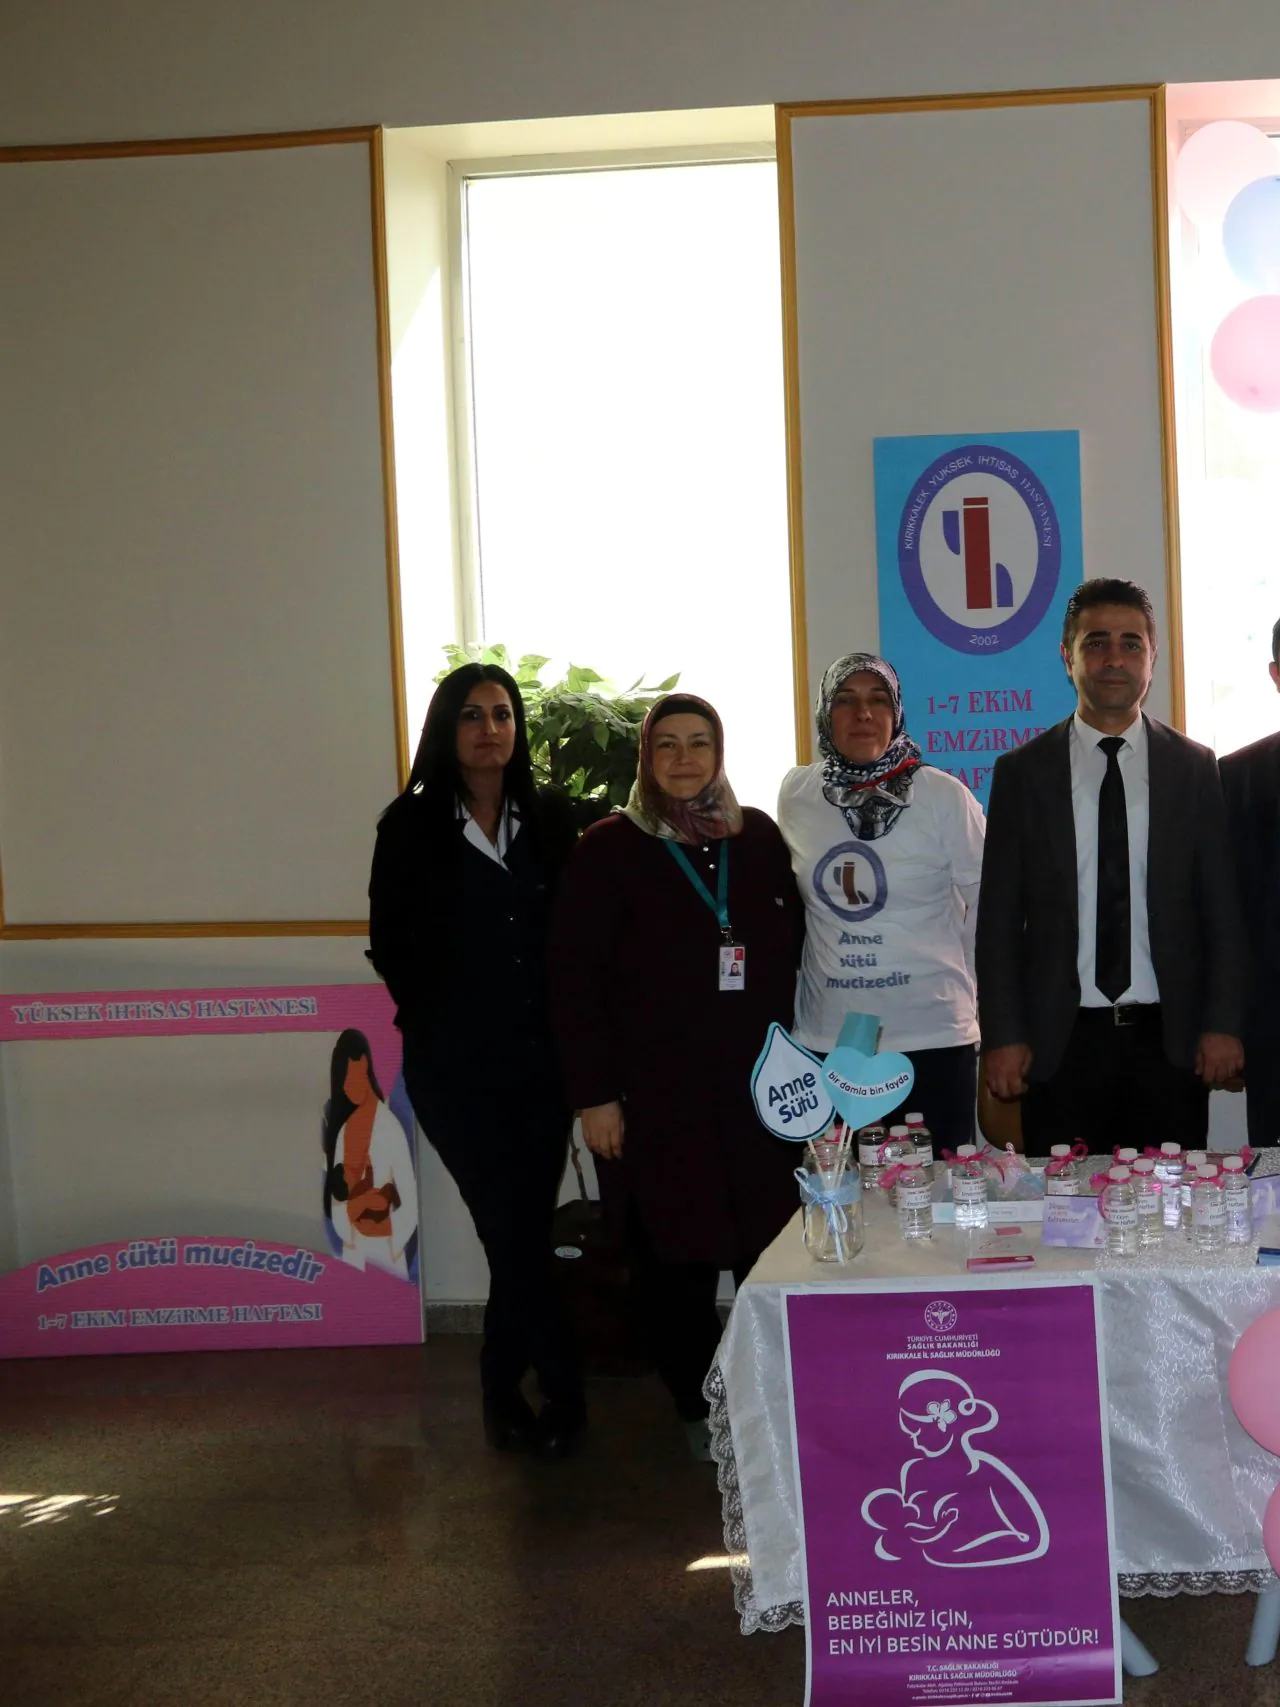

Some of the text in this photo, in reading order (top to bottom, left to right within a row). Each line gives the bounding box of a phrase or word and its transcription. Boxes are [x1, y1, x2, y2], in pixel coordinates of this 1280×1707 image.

[968, 634, 1000, 646] 2002
[927, 695, 960, 715] 1-7
[838, 931, 884, 945] Anne
[840, 953, 877, 968] sütü
[826, 971, 911, 989] mucizedir
[13, 1002, 101, 1024] YÜKSEK
[768, 1072, 817, 1107] Anne
[828, 1071, 909, 1096] bir damla bin fayda
[778, 1091, 819, 1124] Sütü
[37, 1239, 324, 1292] Anne sütü mucizedir
[38, 1315, 67, 1330] 1-7
[233, 1304, 322, 1323] HAFTASI
[906, 1333, 978, 1343] TÜRKİYE CUMHURİYETİ
[907, 1340, 979, 1350] SAĞLIK BAKANLIĞI
[886, 1348, 1001, 1360] KIRIKKALE İL SAĞLIK MÜDÜRLÜĞÜ
[826, 1589, 919, 1608] ANNELER,
[828, 1608, 973, 1632] BEBEĞİNİZ İÇİN,
[829, 1627, 1100, 1655] EN İYİ BESİN ANNE SÜTÜDÜR!
[909, 1674, 942, 1682] KIRIKKALE
[950, 1671, 973, 1680] SAĞLIK
[974, 1668, 1017, 1678] MÜDÜRLÜĞÜ
[939, 1662, 962, 1671] SAĞLIK
[963, 1661, 999, 1671] BAKANLIĞI
